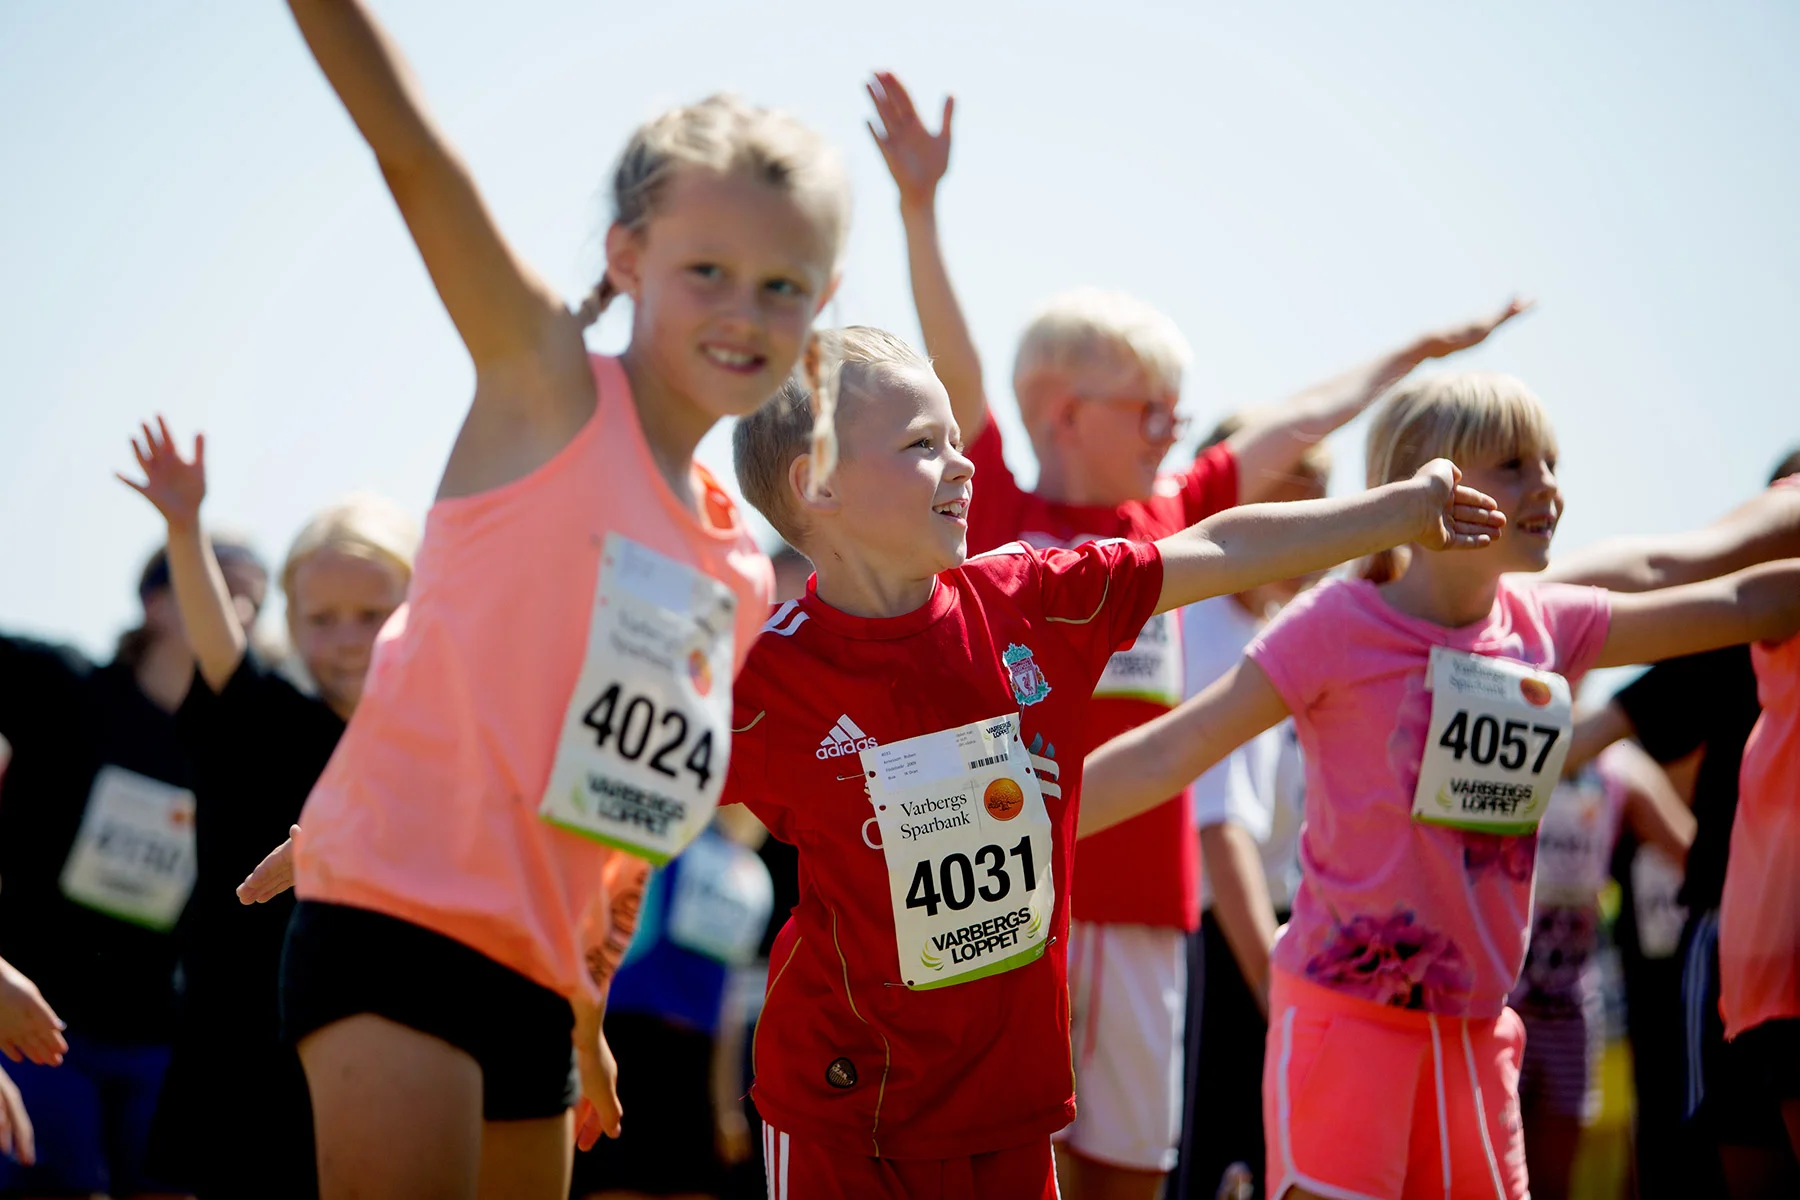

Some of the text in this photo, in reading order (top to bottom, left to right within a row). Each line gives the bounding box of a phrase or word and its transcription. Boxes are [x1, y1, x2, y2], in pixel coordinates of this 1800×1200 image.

[581, 681, 713, 791] 4024
[815, 737, 878, 760] adidas
[1439, 709, 1560, 775] 4057
[900, 793, 968, 818] Varbergs
[1451, 778, 1533, 799] VARBERGS
[1461, 797, 1520, 815] LOPPET
[900, 810, 971, 841] Sparbank
[905, 835, 1037, 917] 4031
[931, 906, 1032, 952] VARBERGS
[950, 927, 1020, 964] LOPPET
